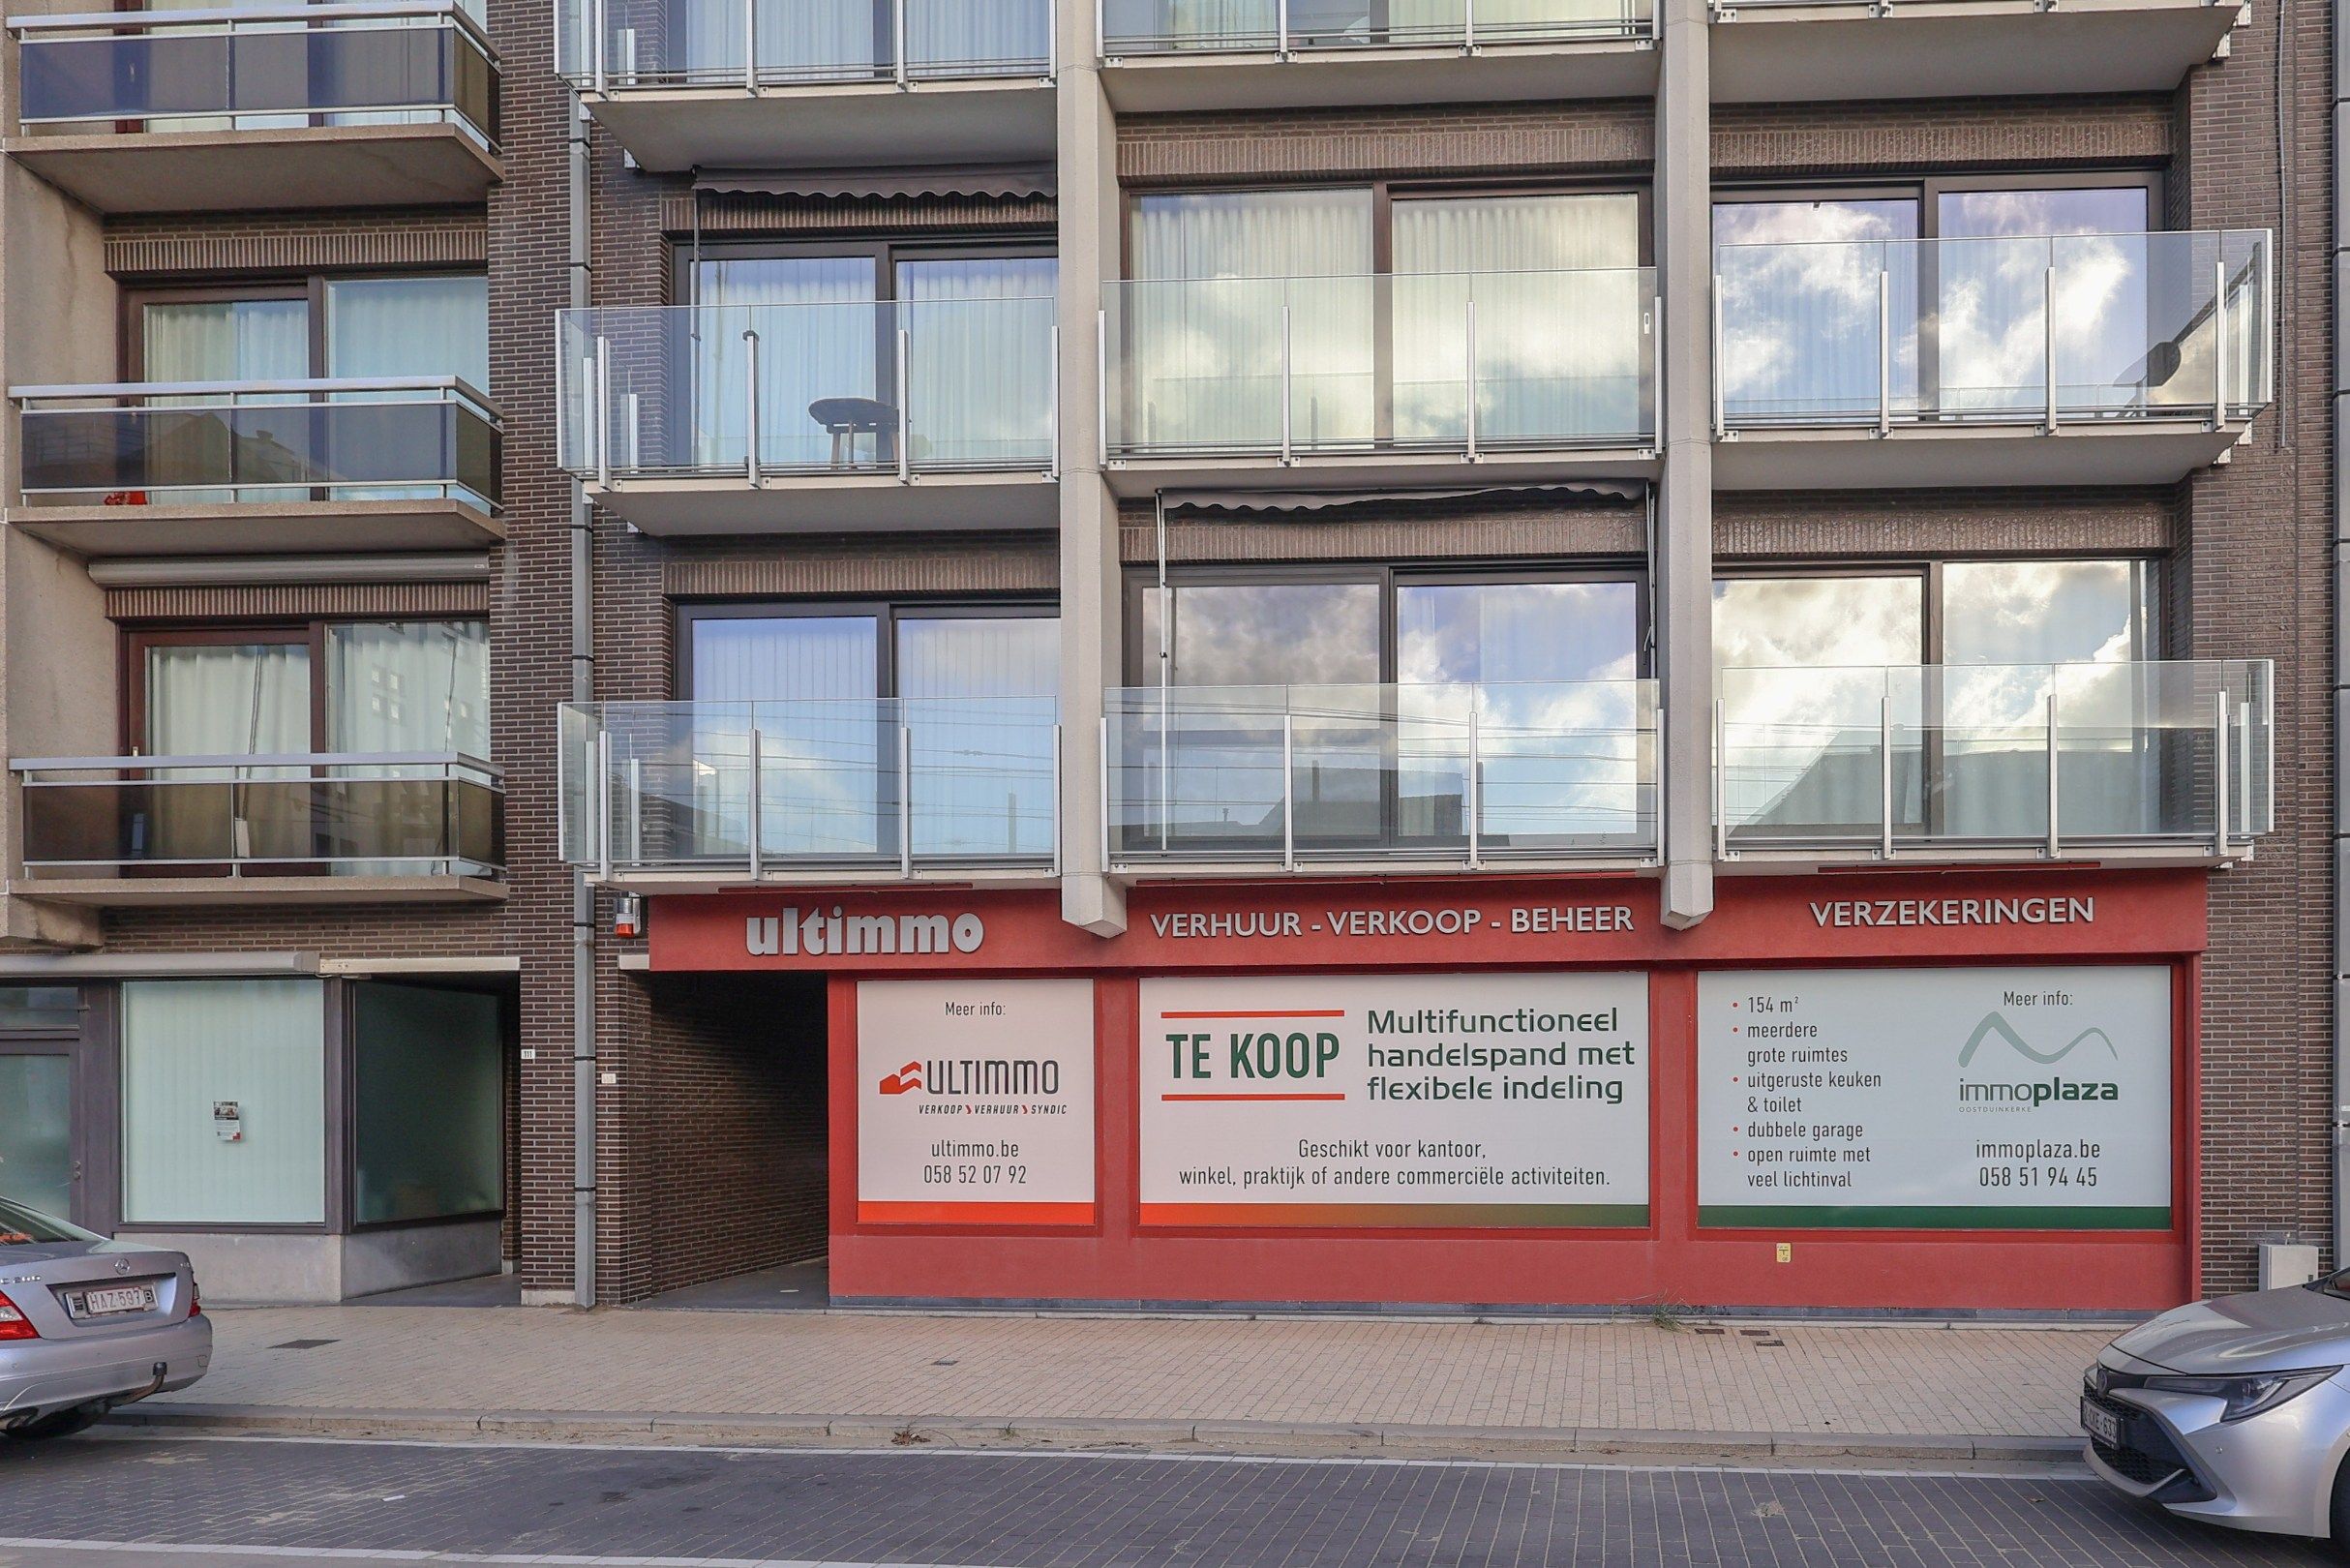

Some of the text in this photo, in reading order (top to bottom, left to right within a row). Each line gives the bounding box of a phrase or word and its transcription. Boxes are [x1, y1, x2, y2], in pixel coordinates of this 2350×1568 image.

[1810, 897, 2095, 927] VERZEKERINGEN
[746, 905, 984, 955] ultimmo
[1150, 912, 1303, 939] VERHUUR
[1327, 910, 1482, 937] VERKOOP
[1511, 906, 1635, 933] BEHEER
[946, 1001, 1006, 1016] Meer info:
[1747, 997, 1774, 1013] 154
[2004, 991, 2073, 1007] Meer info:
[1367, 1007, 1618, 1035] Multifunctioneel
[1747, 1022, 1819, 1039] meerdere
[1165, 1033, 1341, 1079] TE KOOP
[1367, 1040, 1636, 1071] handelspand met
[1747, 1046, 1849, 1066] grote ruimtes
[927, 1060, 1059, 1095] ULTIMMO
[1747, 1071, 1882, 1091] uitgeruste keuken
[1367, 1074, 1623, 1104] flexibele indeling
[1959, 1077, 2119, 1107] immoplaza
[919, 1104, 1067, 1114] VERKOOP VERHUUR SYNDIC
[1747, 1096, 1802, 1113] & toilet
[1747, 1121, 1863, 1141] dubbele garage
[931, 1139, 1020, 1158] ultimmo.be
[1298, 1139, 1487, 1161] Geschikt voor kantoor,
[1748, 1146, 1871, 1166] open ruimte met
[1975, 1140, 2101, 1160] immoplaza.be
[923, 1165, 1027, 1184] 058 52 07 92
[1179, 1165, 1611, 1190] winkel, praktijk of andere commerciële activiteiten.
[1747, 1171, 1852, 1188] veel lichtinval
[1979, 1168, 2097, 1188] 058 51 94 45
